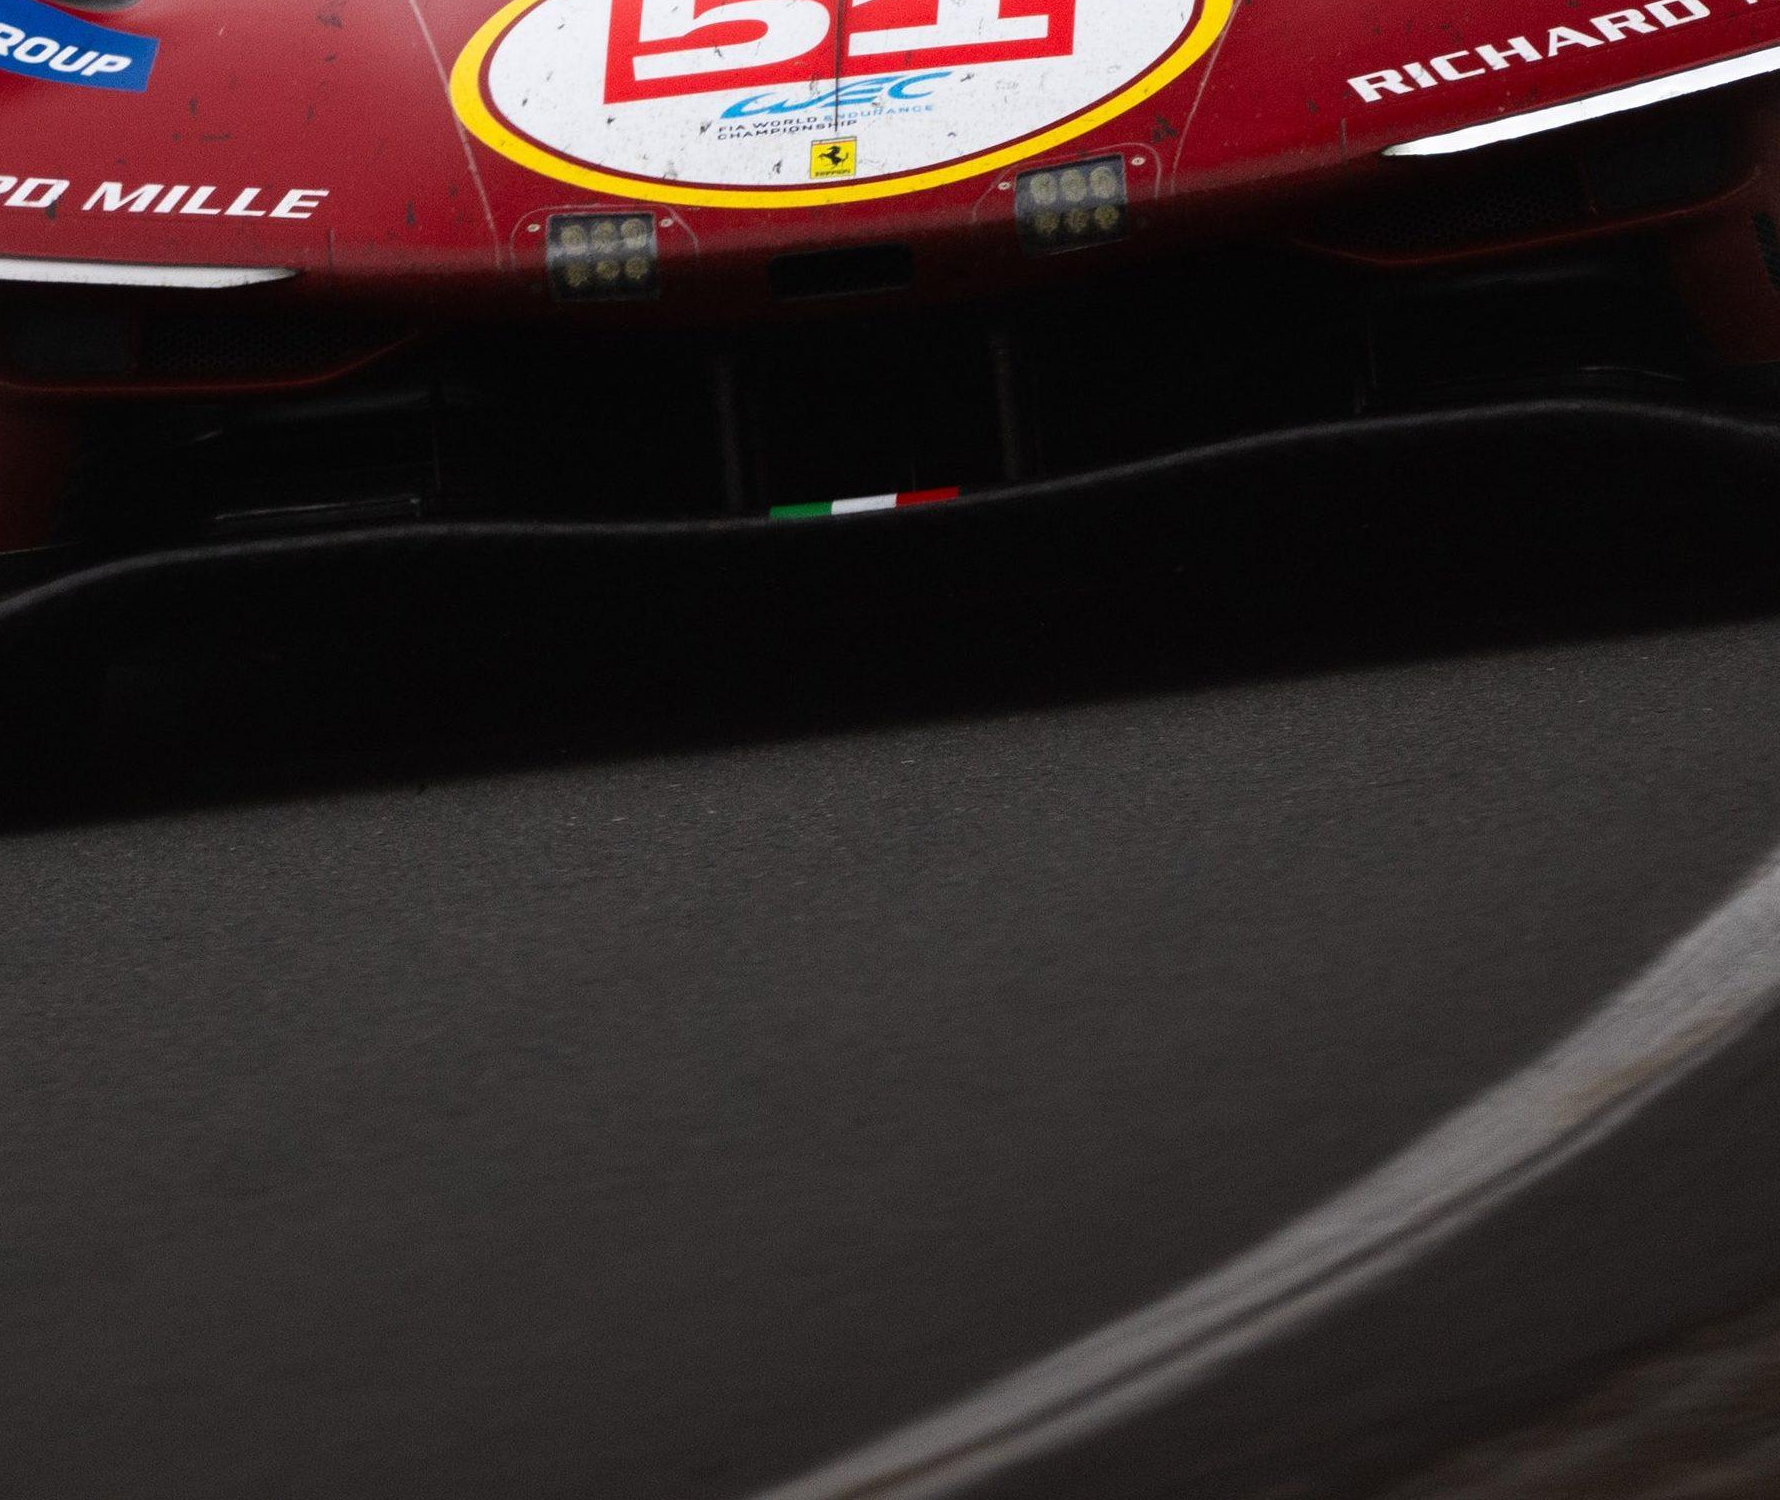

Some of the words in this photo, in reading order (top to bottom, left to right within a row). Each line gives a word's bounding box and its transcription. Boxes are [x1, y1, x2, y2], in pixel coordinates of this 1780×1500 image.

[720, 70, 953, 120] WEC
[717, 119, 859, 141] CHAMPIONSHIP
[718, 122, 745, 133] FIA
[752, 116, 819, 130] WORLD
[822, 103, 936, 122] ENDURANCE
[82, 179, 330, 220] MILLE
